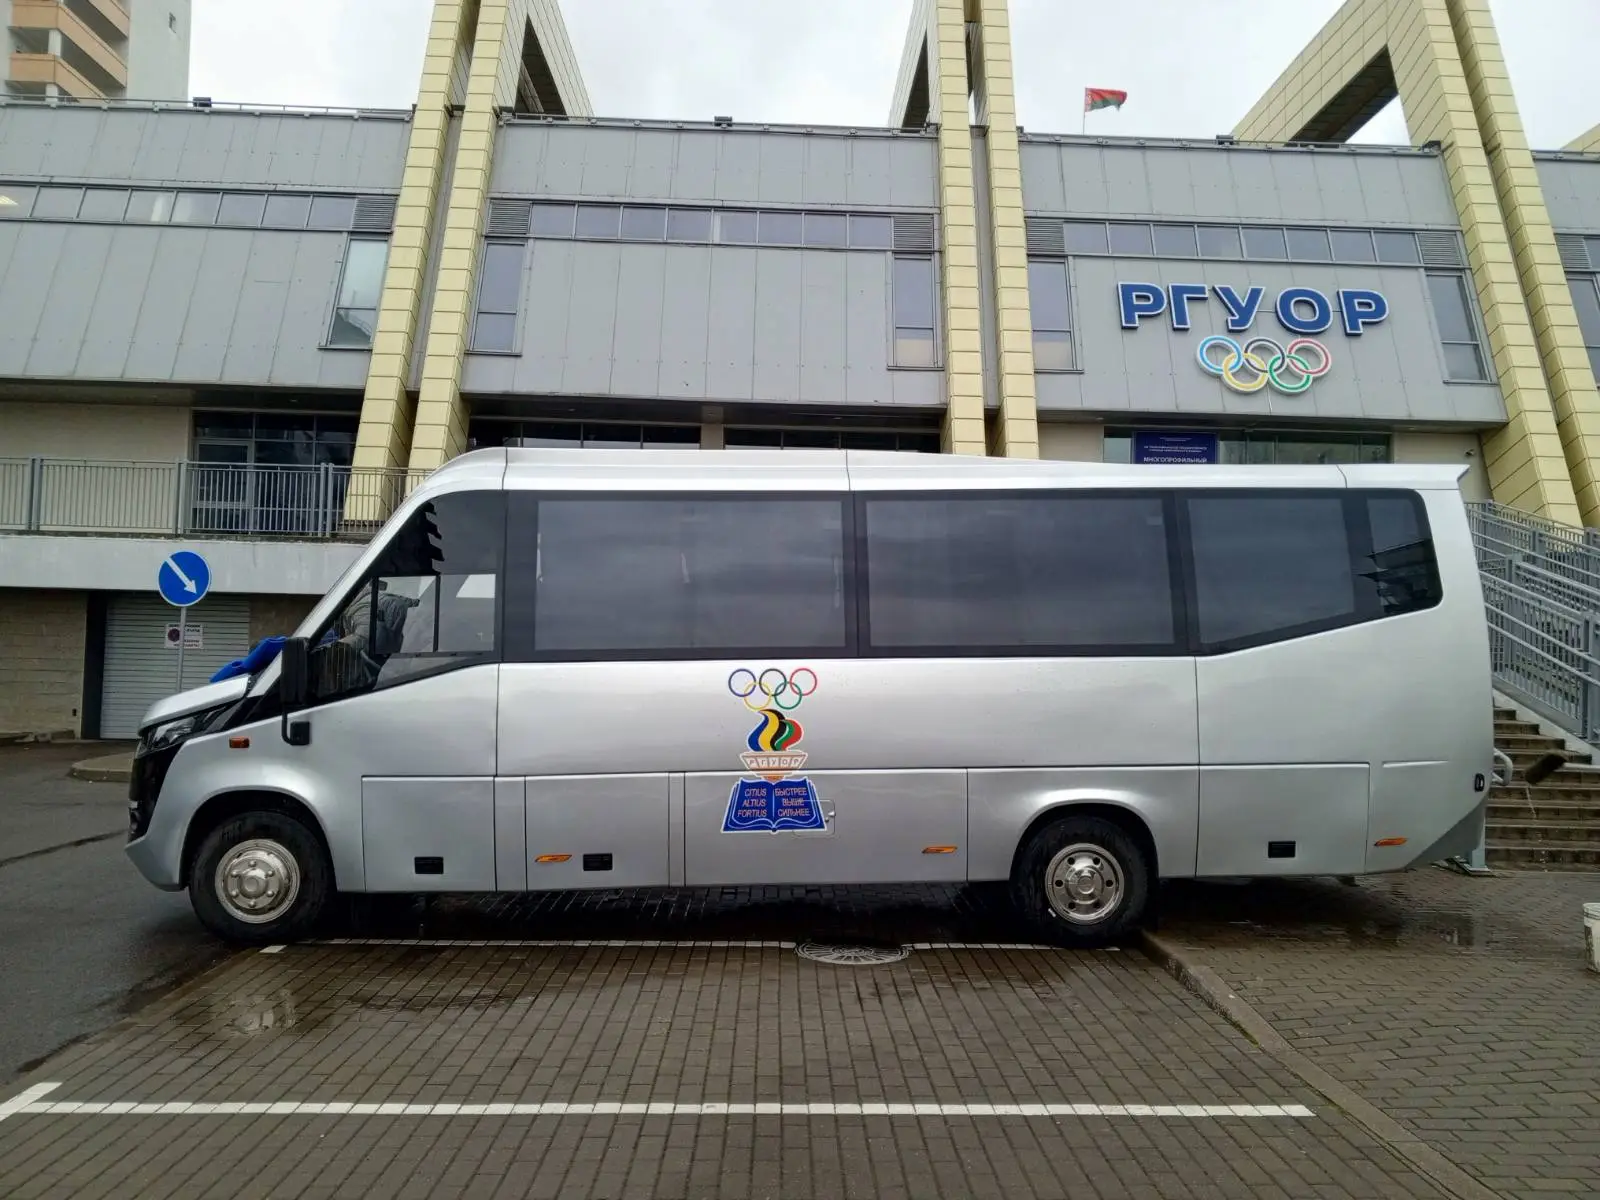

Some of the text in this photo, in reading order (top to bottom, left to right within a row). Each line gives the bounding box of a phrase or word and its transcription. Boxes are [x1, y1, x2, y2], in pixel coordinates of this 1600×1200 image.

[1117, 282, 1389, 335] РГУОР
[748, 758, 800, 766] РГУОР
[744, 788, 767, 797] CITIUS
[774, 787, 807, 796] БЫСТРЕЕ
[742, 798, 766, 807] ALTIUS
[783, 798, 804, 807] ВЫШЕ
[737, 809, 767, 818] FORTIUS
[777, 808, 810, 817] СИЛЬНЕЕ
